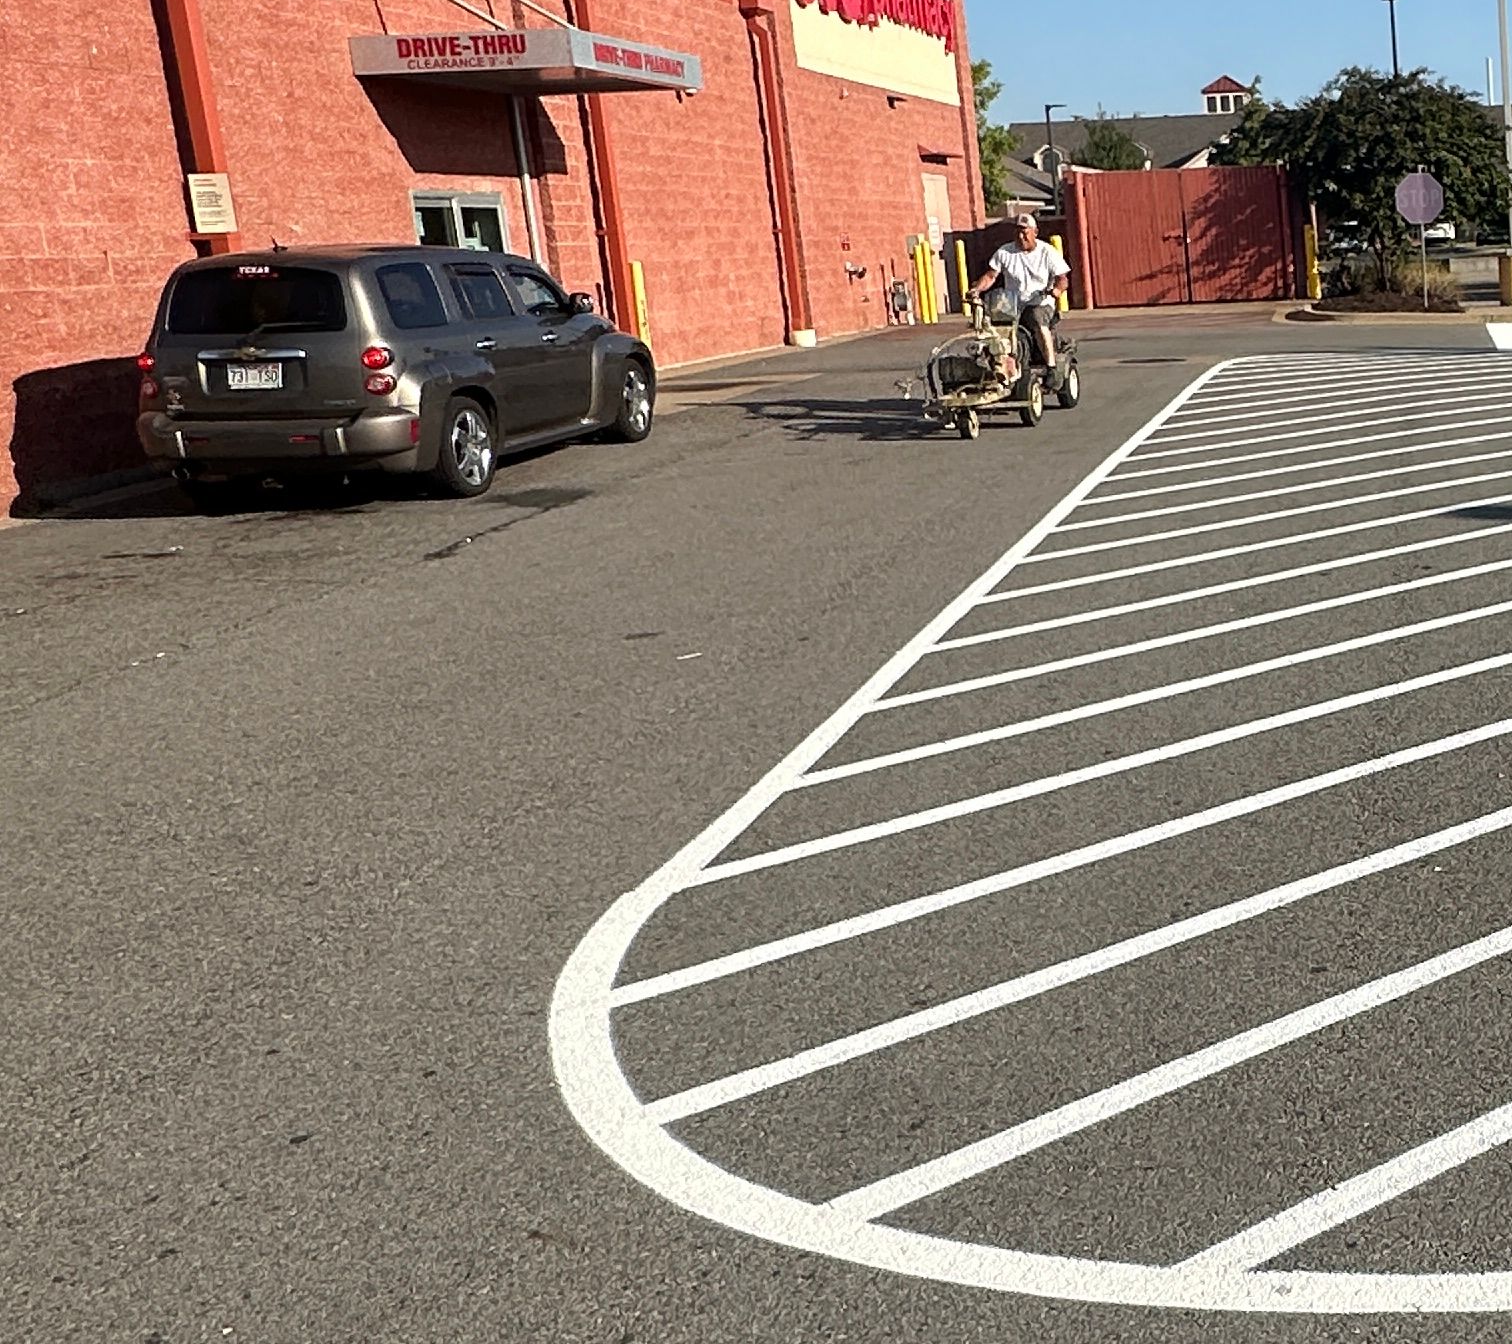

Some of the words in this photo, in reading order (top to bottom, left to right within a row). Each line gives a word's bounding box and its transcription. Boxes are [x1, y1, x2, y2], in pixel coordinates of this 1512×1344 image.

[396, 34, 527, 58] DRIVE-THRU
[406, 56, 485, 71] CLEARANCE
[1399, 188, 1440, 208] STOP
